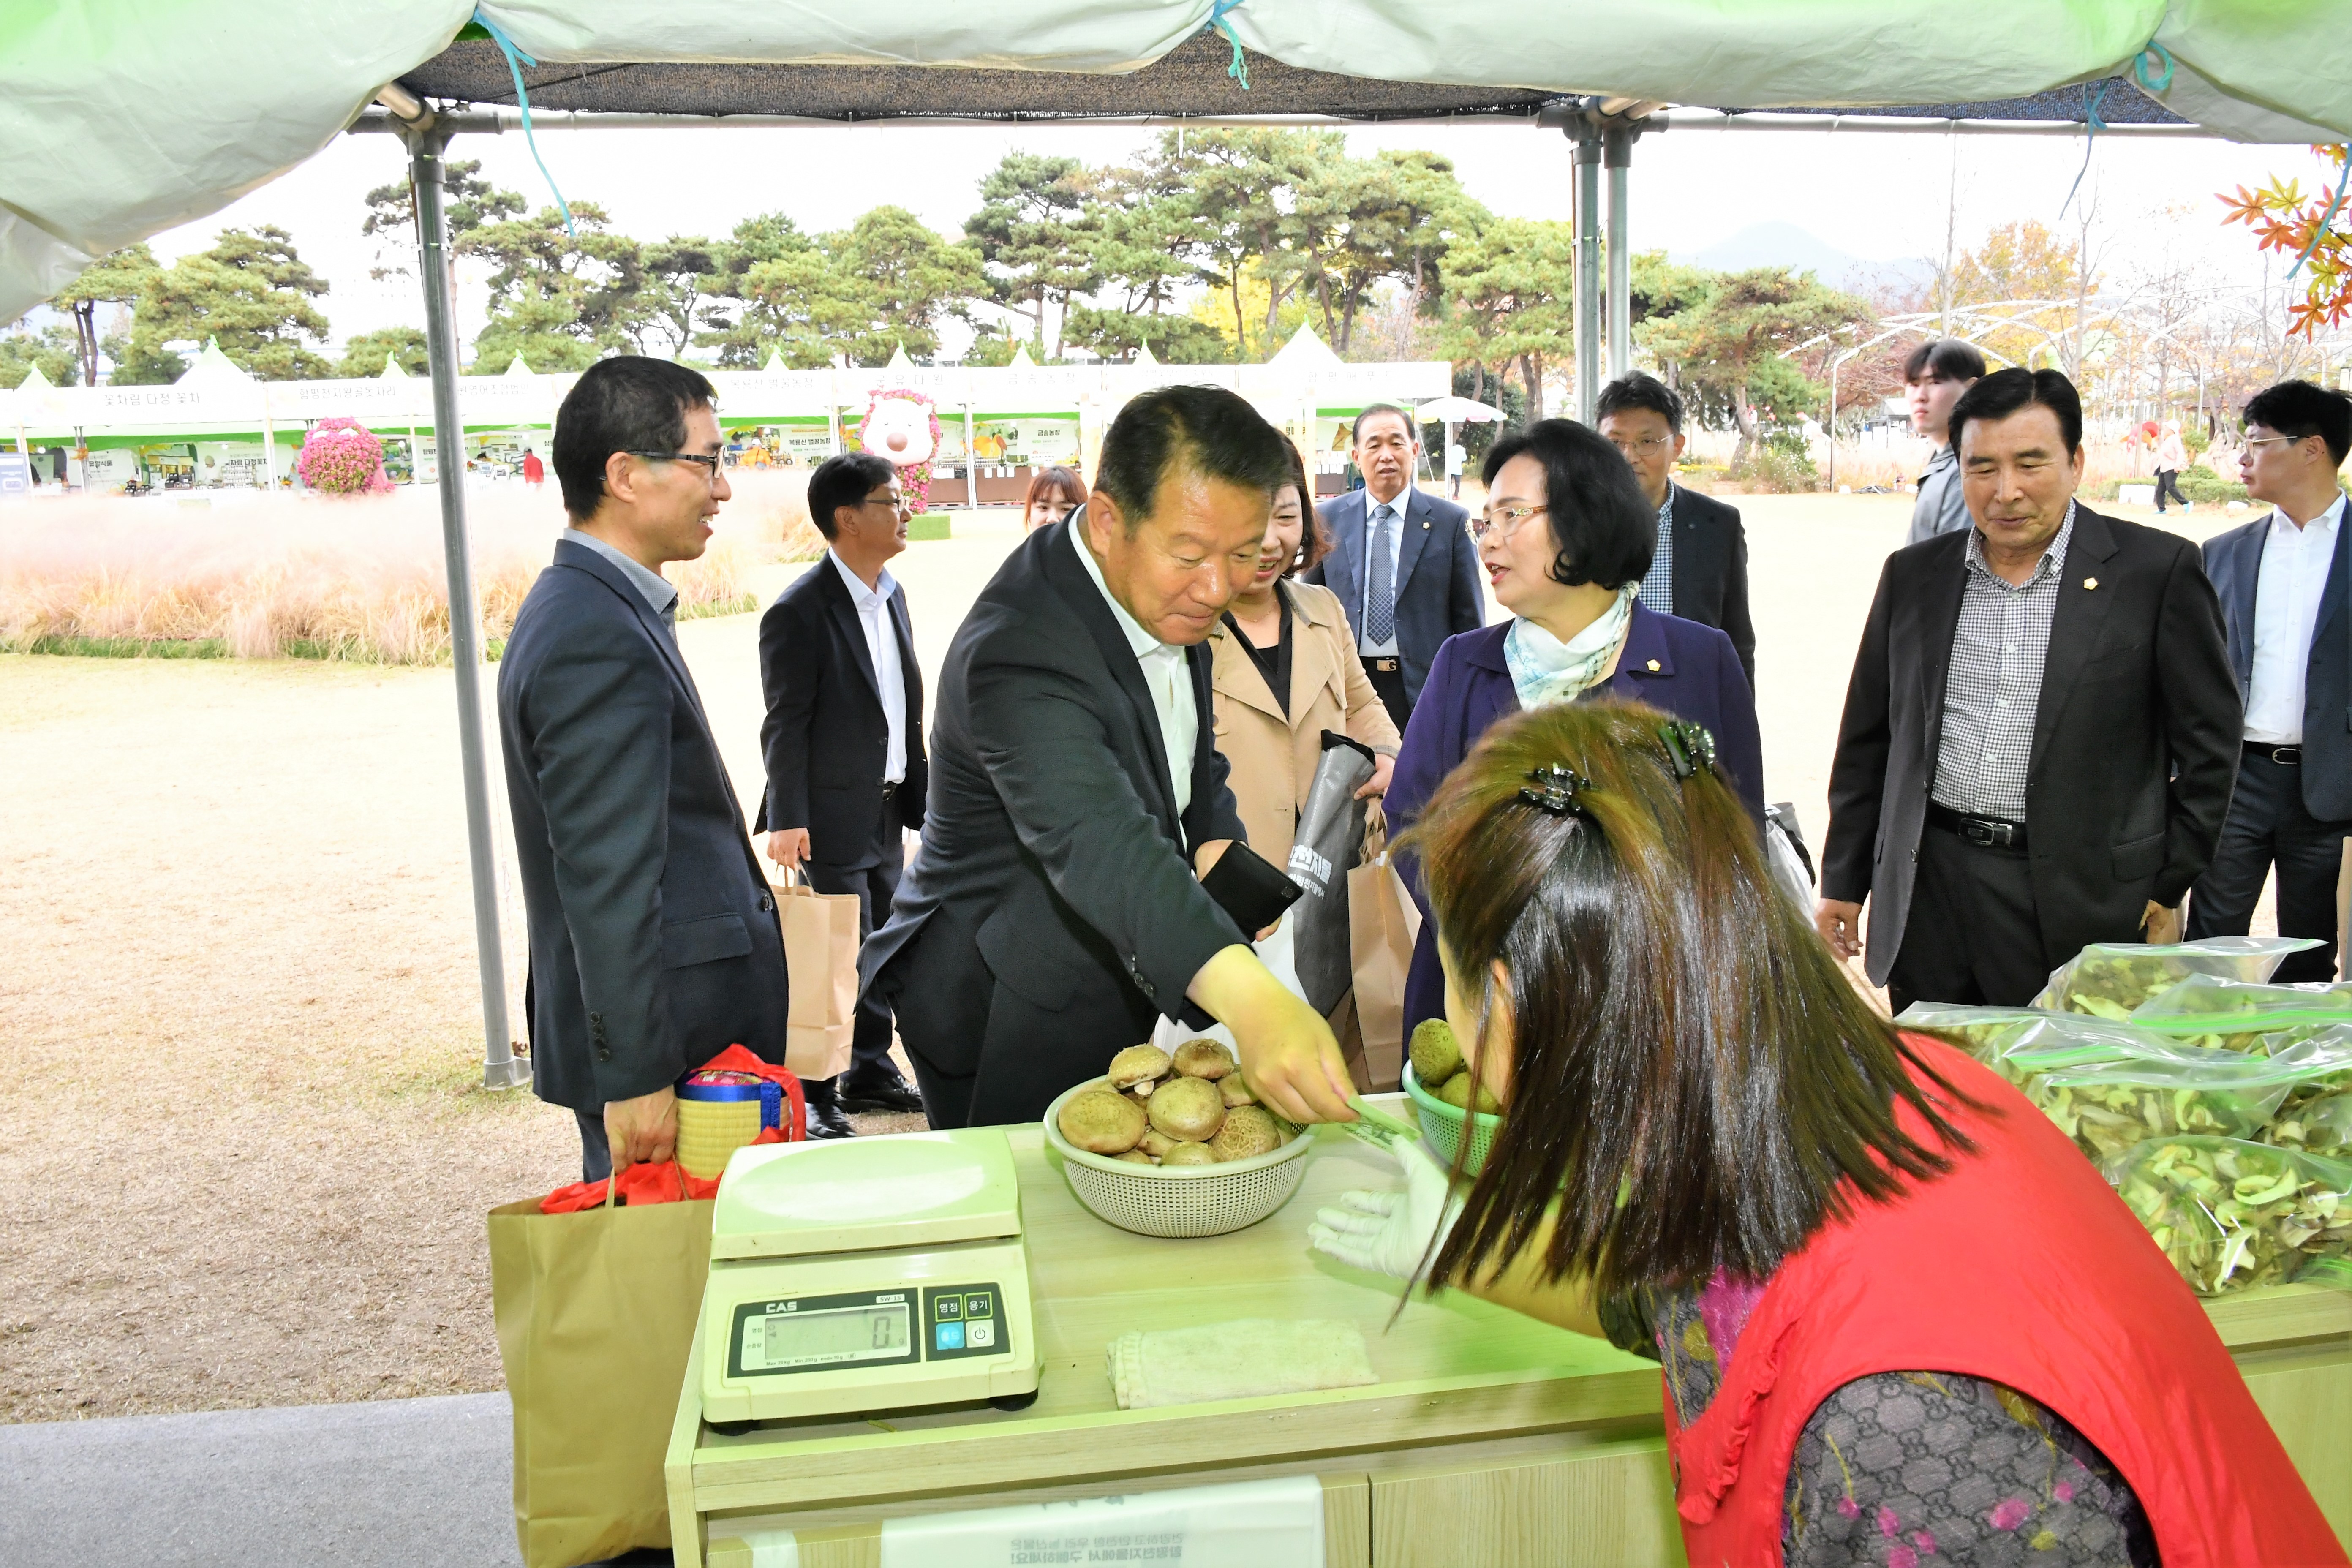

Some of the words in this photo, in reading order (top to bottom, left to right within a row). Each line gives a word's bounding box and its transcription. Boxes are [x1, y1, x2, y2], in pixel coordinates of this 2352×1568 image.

[769, 378, 813, 389] 벌꿀농장
[299, 386, 395, 399] 함평천지왕골돗자리
[104, 393, 141, 406] 꽃차림
[146, 393, 170, 405] 다정
[177, 392, 200, 404] 꽃차
[1287, 845, 1332, 885] 천지몰
[765, 1301, 797, 1313] CAS
[939, 1302, 958, 1313] 영점
[969, 1300, 988, 1311] 용기
[872, 1316, 891, 1349] 0
[899, 1338, 904, 1346] g
